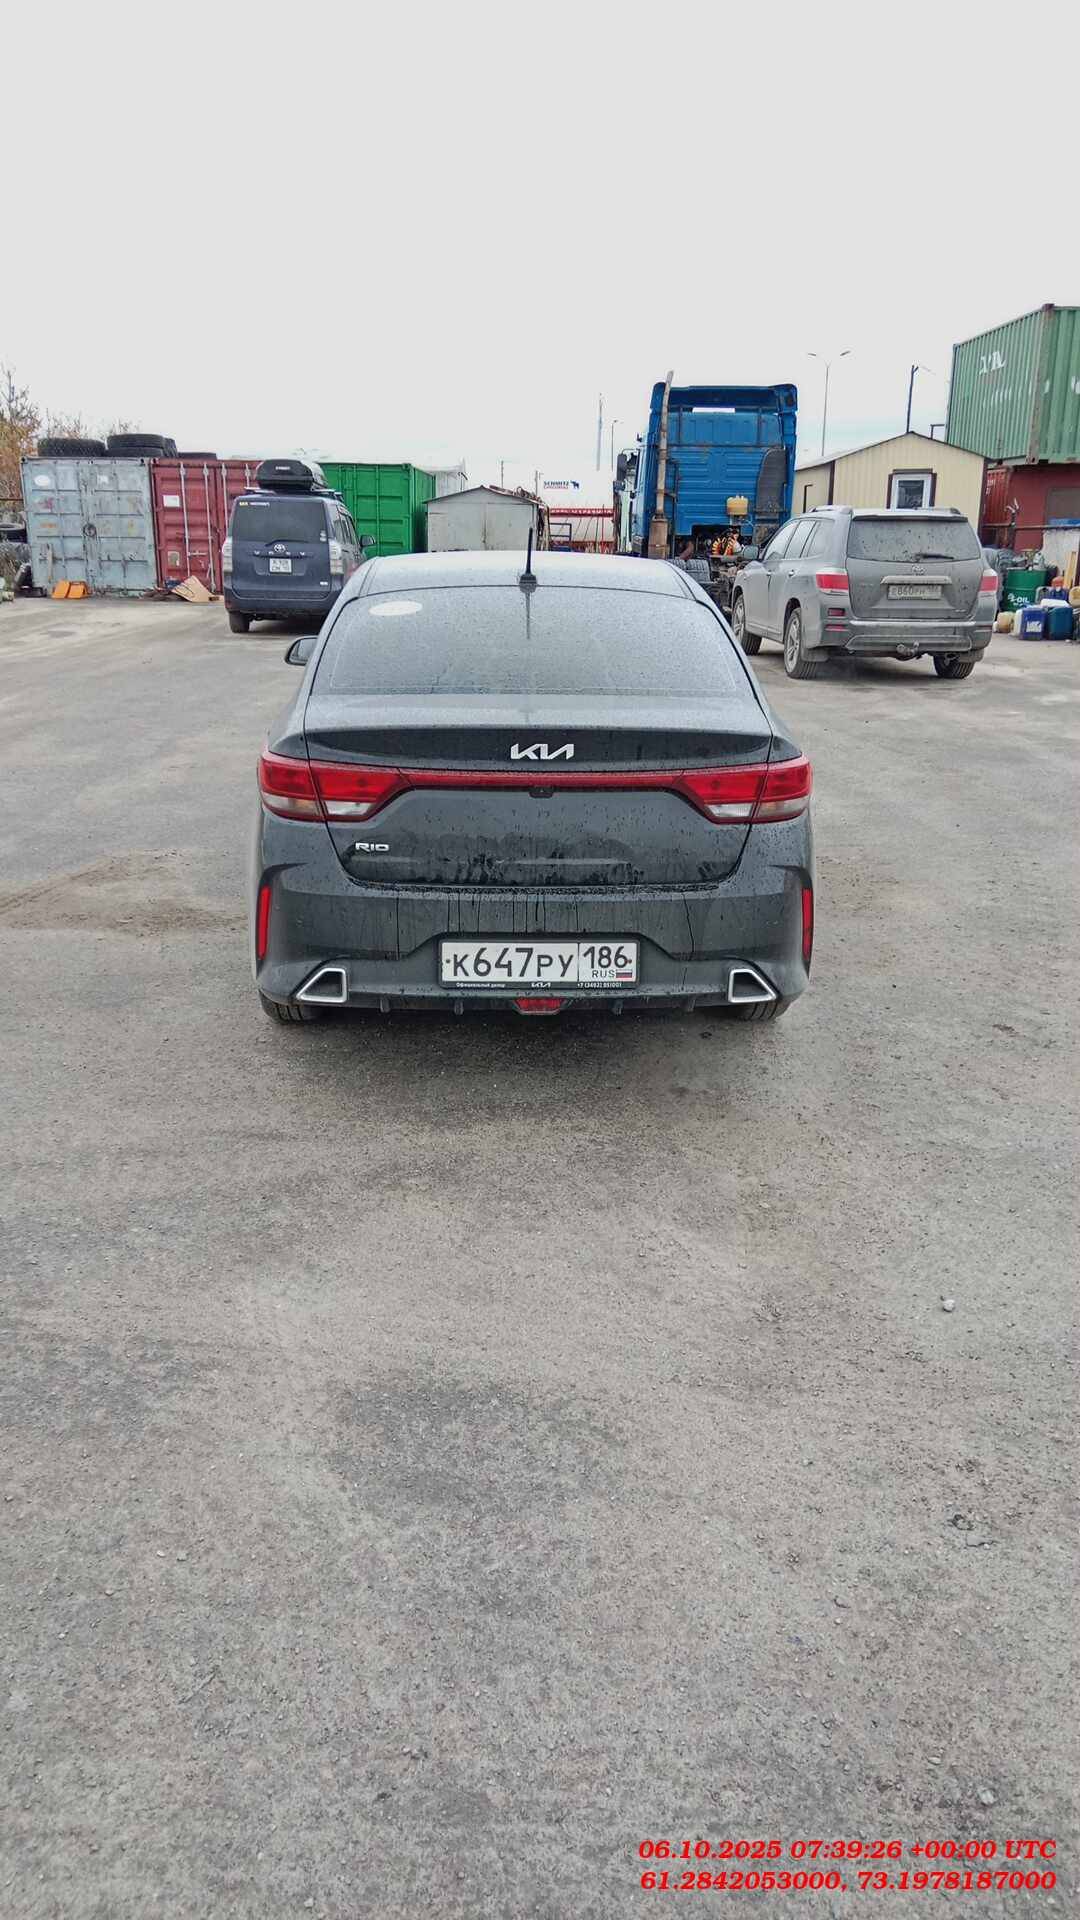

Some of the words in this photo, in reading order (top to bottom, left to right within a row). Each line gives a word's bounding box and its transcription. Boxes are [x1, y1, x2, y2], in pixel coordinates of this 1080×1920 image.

[510, 743, 575, 760] KIA
[355, 842, 390, 852] RIO
[453, 947, 574, 977] К647РУ
[582, 945, 627, 968] 186
[591, 969, 615, 978] RUS
